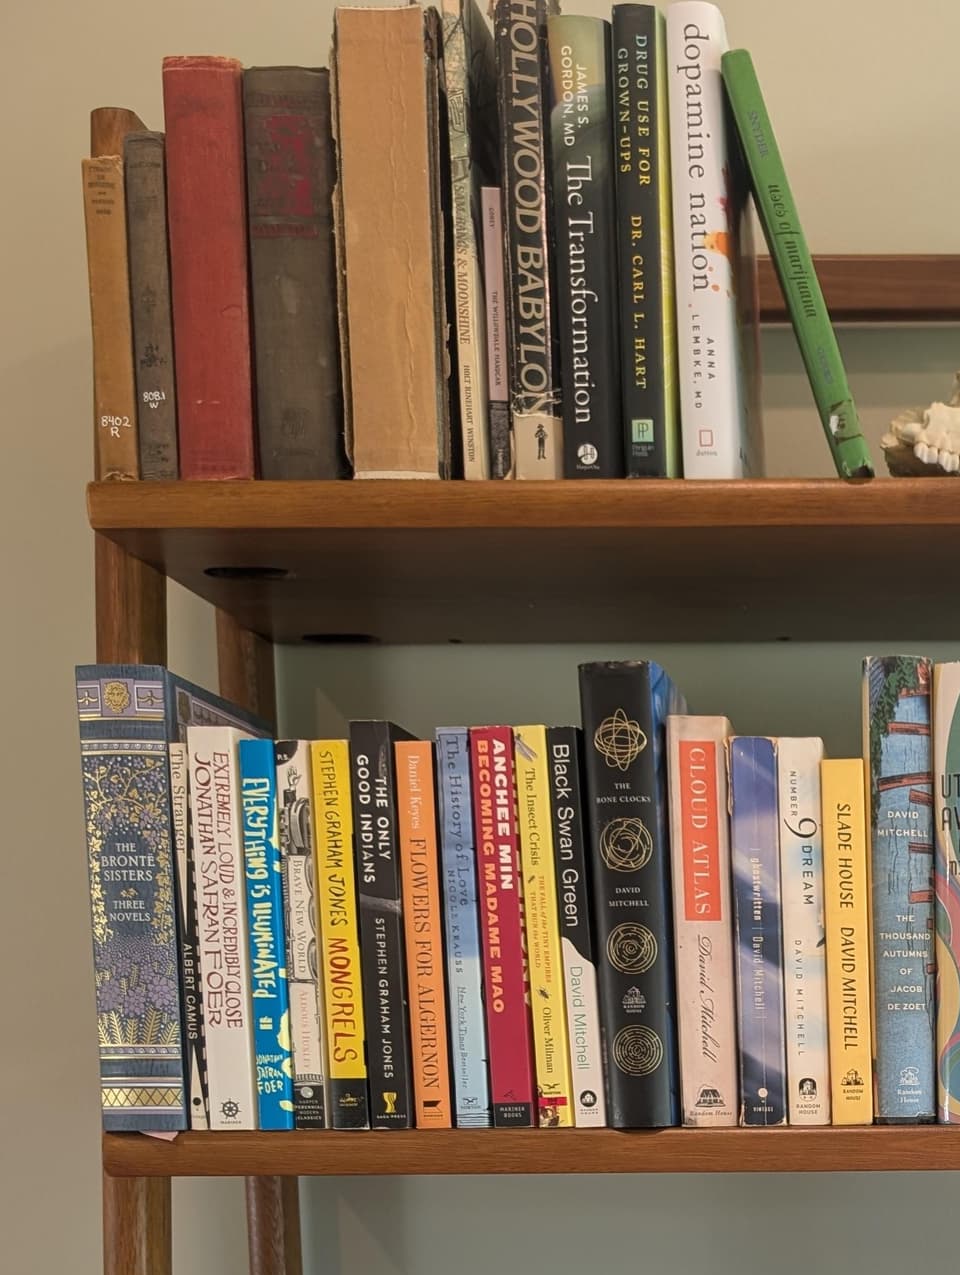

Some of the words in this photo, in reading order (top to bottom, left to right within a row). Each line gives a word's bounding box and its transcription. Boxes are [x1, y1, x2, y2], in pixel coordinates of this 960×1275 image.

[560, 46, 574, 118] GORDON,
[635, 35, 647, 89] DRUG
[576, 64, 588, 114] JAMES
[618, 48, 630, 173] GROWN-UPS
[676, 23, 710, 179] dopamine
[508, 0, 544, 233] HOLLYWOOD
[563, 122, 575, 146] MD
[578, 116, 589, 128] S.
[636, 99, 648, 135] USE
[566, 155, 592, 206] The
[638, 144, 650, 186] FOR
[767, 184, 786, 217] uses
[631, 216, 641, 246] DR.
[689, 191, 710, 291] nation
[776, 220, 800, 240] of
[631, 256, 642, 303] CARL
[785, 240, 817, 318] marijuana
[515, 245, 547, 416] BABYLON
[568, 210, 598, 423] Transformation
[633, 313, 642, 328] L.
[633, 338, 646, 389] HART
[691, 314, 701, 385] LEMBKE,
[706, 338, 716, 379] ANNA
[695, 392, 701, 409] MD
[195, 752, 215, 857] JONATHAN
[356, 754, 370, 804] GOOD
[375, 776, 388, 801] THE
[476, 740, 494, 857] BECOMING
[492, 739, 510, 836] ANCHEE
[689, 748, 707, 830] CLOUD
[116, 842, 136, 852] THE
[359, 814, 376, 883] INDIANS
[376, 806, 392, 860] ONLY
[837, 803, 851, 850] SLADE
[101, 852, 154, 867] BRONTË
[104, 870, 153, 882] SISTERS
[498, 843, 513, 889] MIN
[692, 839, 710, 915] ATLAS
[839, 858, 853, 909] HOUSE
[113, 900, 144, 910] THREE
[201, 861, 218, 942] SAFRAN
[409, 838, 432, 933] FLOWERS
[483, 863, 501, 959] MADAME
[110, 911, 150, 922] NOVELS
[182, 943, 194, 990] ALBERT
[413, 939, 433, 977] FOR
[204, 946, 222, 1026] FOER
[329, 938, 358, 1062] MONGRELS
[490, 965, 504, 1013] MAO
[186, 996, 198, 1040] CAMUS
[417, 983, 441, 1088] ALGERNON
